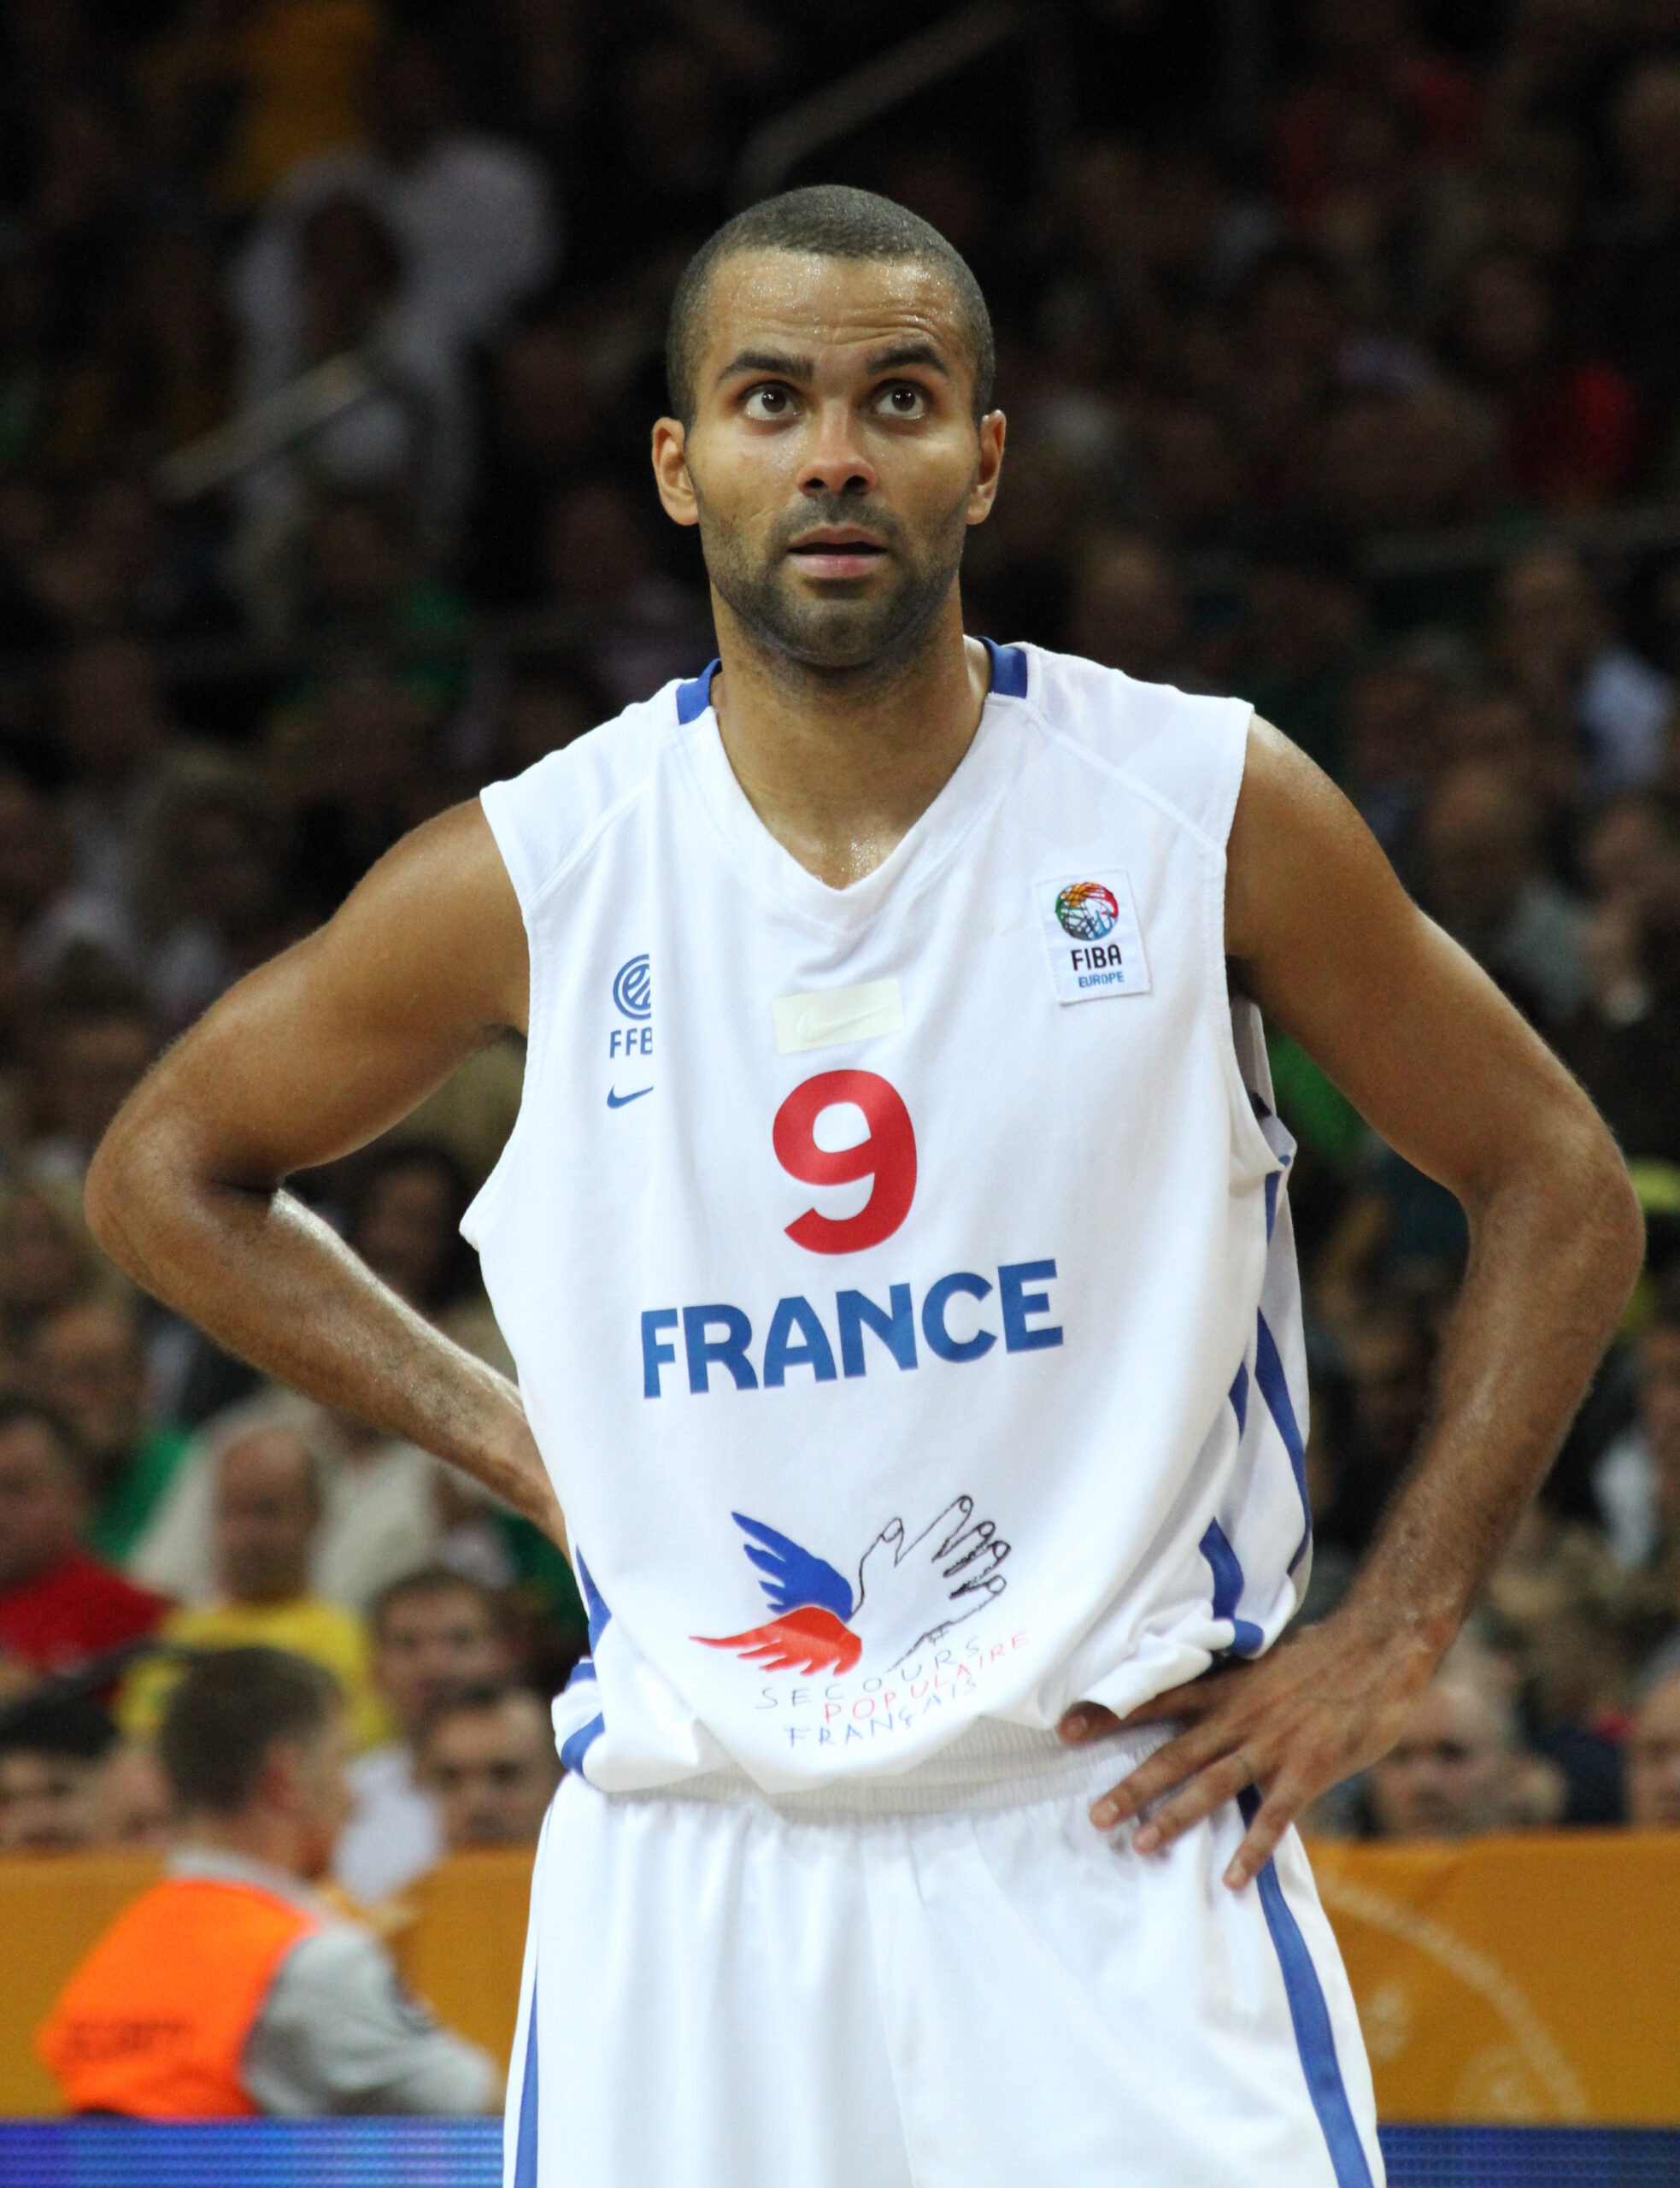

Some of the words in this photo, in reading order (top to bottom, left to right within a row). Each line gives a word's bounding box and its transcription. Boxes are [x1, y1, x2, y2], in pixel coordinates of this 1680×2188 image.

[1071, 944, 1122, 971] FIBA
[1078, 971, 1124, 988] EUROPE
[772, 1069, 917, 1255] 9
[641, 1259, 1064, 1398] FRANCE
[755, 1637, 980, 1709] SECOURS
[825, 1630, 1027, 1723] POPULAIRE
[784, 1676, 977, 1748] FRANÇAIS
